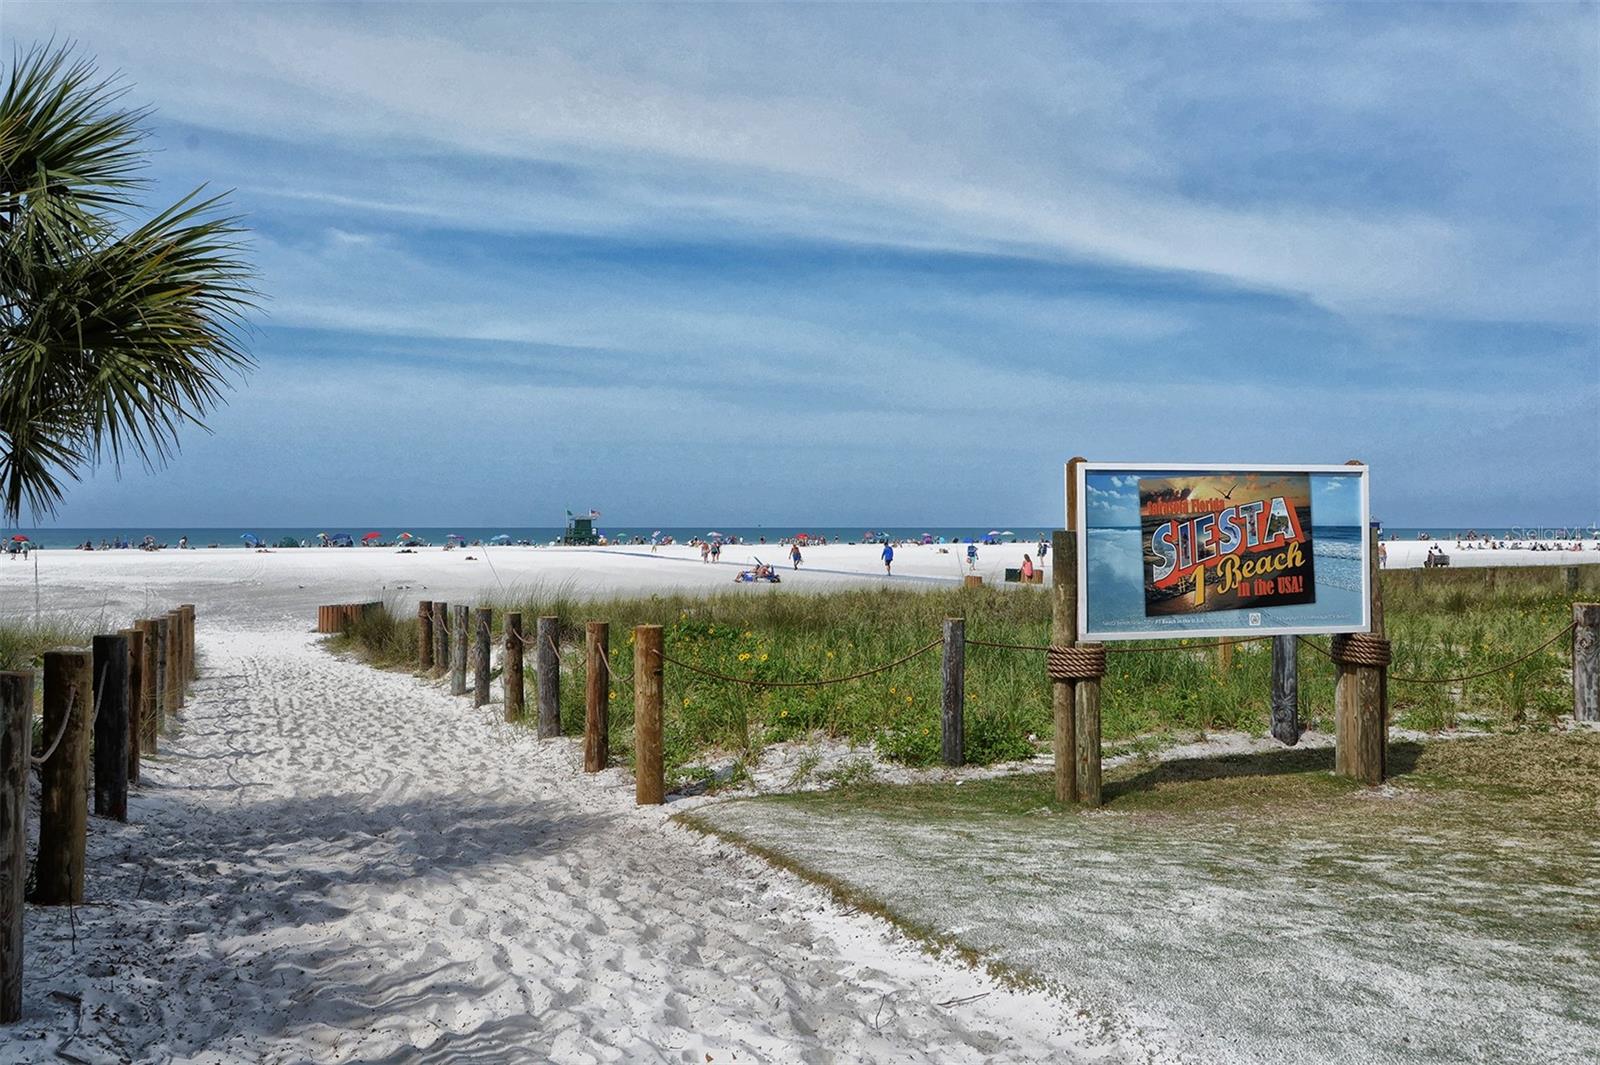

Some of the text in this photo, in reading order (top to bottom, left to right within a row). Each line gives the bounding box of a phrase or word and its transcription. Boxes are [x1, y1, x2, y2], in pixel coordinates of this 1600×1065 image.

[1191, 498, 1225, 513] Florida
[1152, 496, 1298, 584] SIESTA
[1177, 542, 1306, 607] #1 Beach
[1237, 575, 1304, 597] in the USA!
